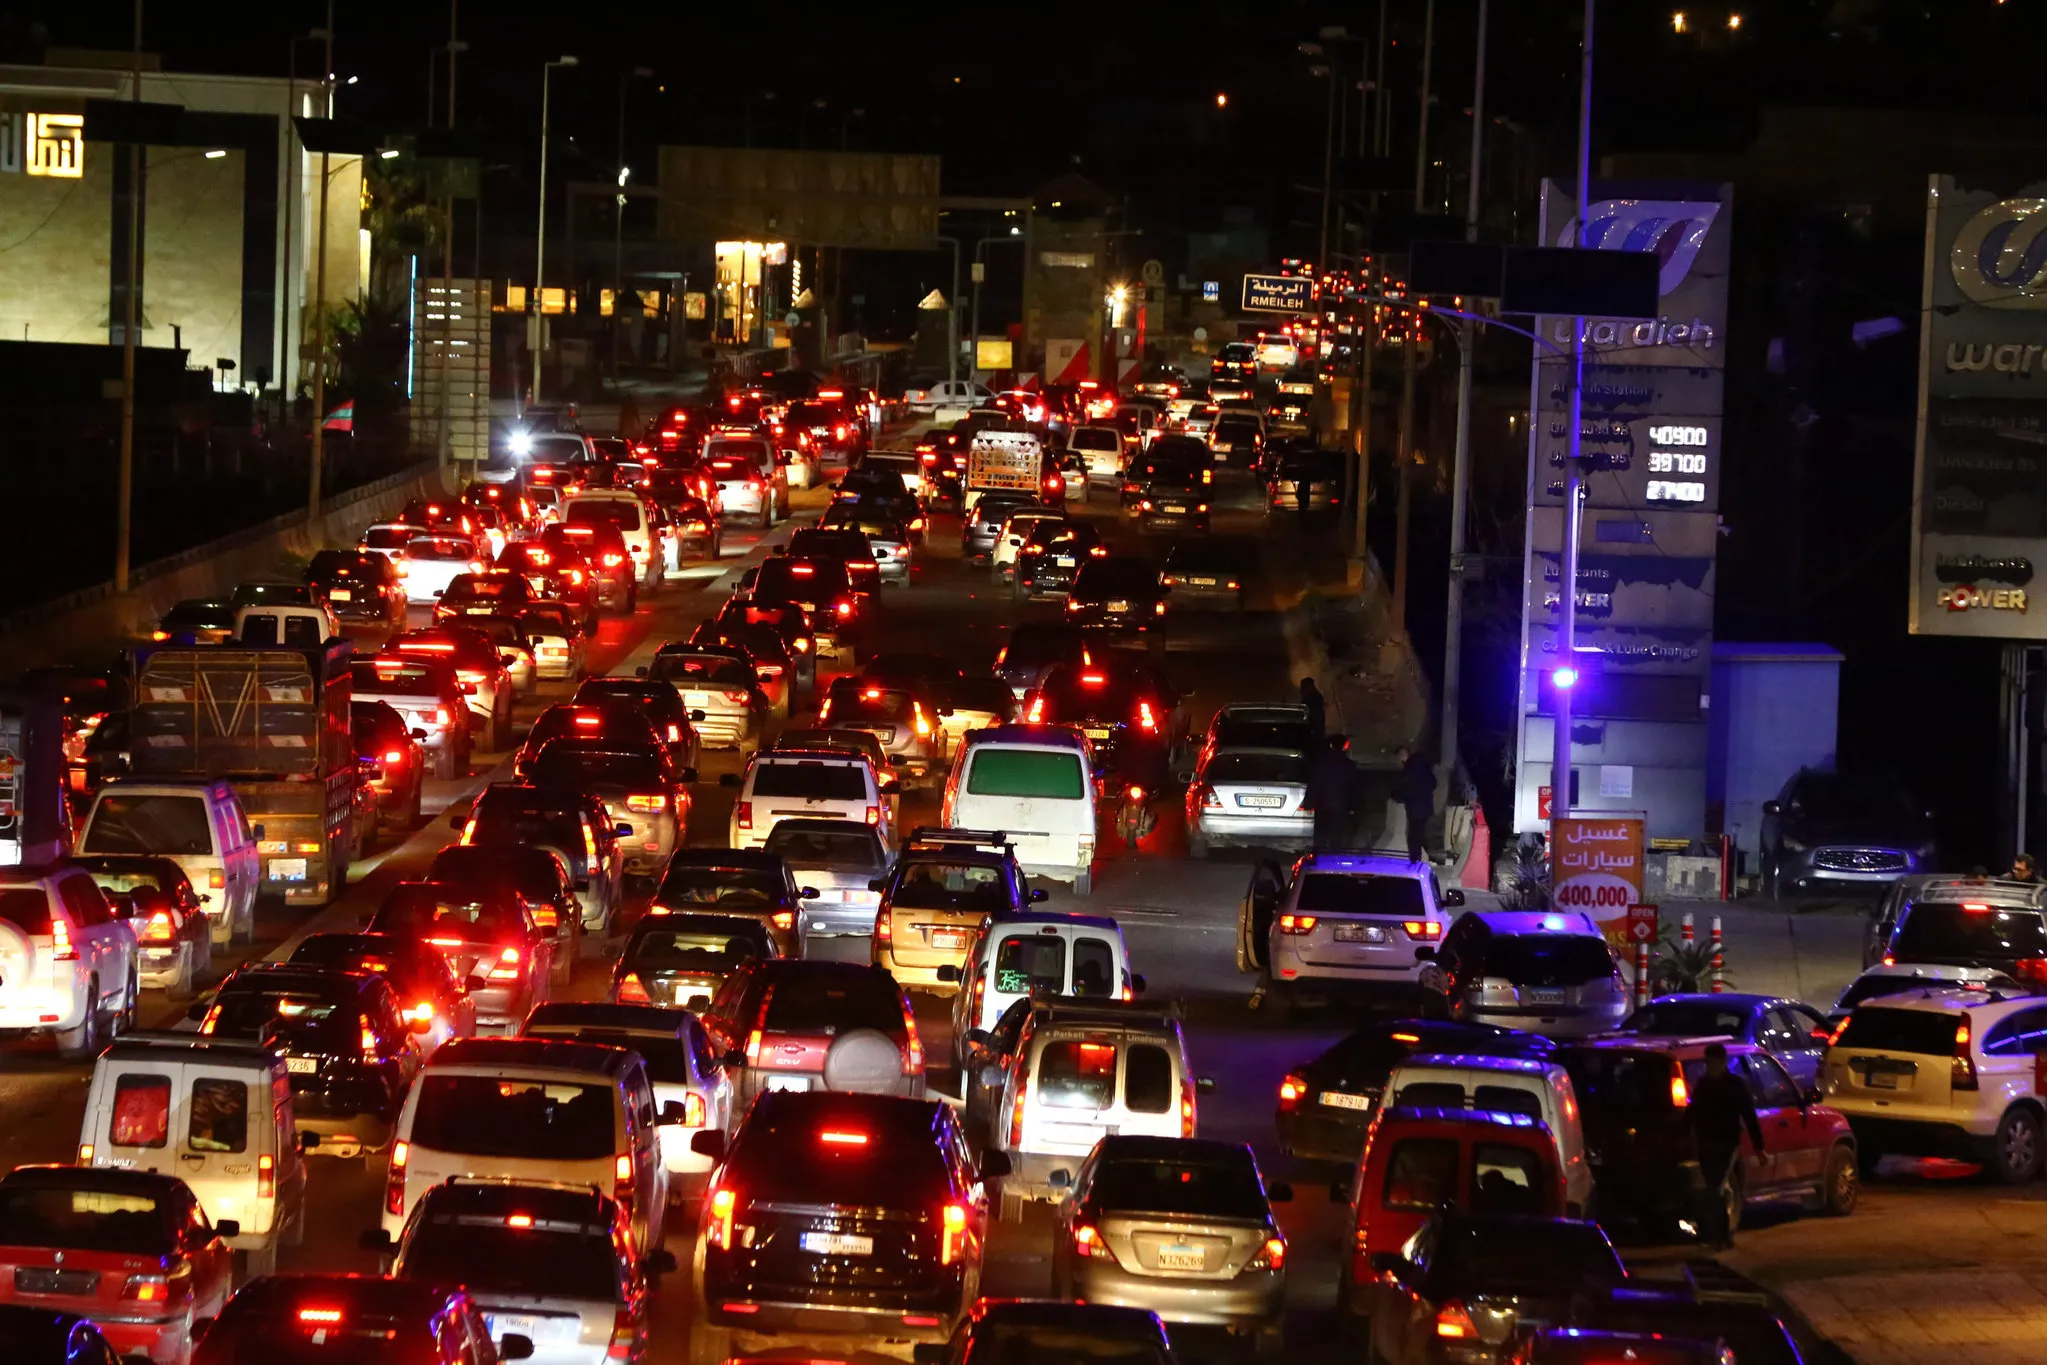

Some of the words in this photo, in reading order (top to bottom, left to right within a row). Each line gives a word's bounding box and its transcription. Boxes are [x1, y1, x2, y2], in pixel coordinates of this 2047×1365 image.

[1251, 279, 1303, 295] الرميلة
[1250, 296, 1304, 309] RMEILEH
[1946, 342, 2047, 372] war
[1649, 426, 1707, 446] 40900
[1936, 587, 2026, 609] POWER
[1617, 644, 1648, 655] Lube
[1650, 644, 1698, 659] Change
[1566, 824, 1629, 844] غسيل
[1561, 850, 1635, 871] سيارات
[1558, 885, 1628, 908] 400,000
[1630, 907, 1655, 918] OPEN
[1053, 1030, 1085, 1040] Parkett
